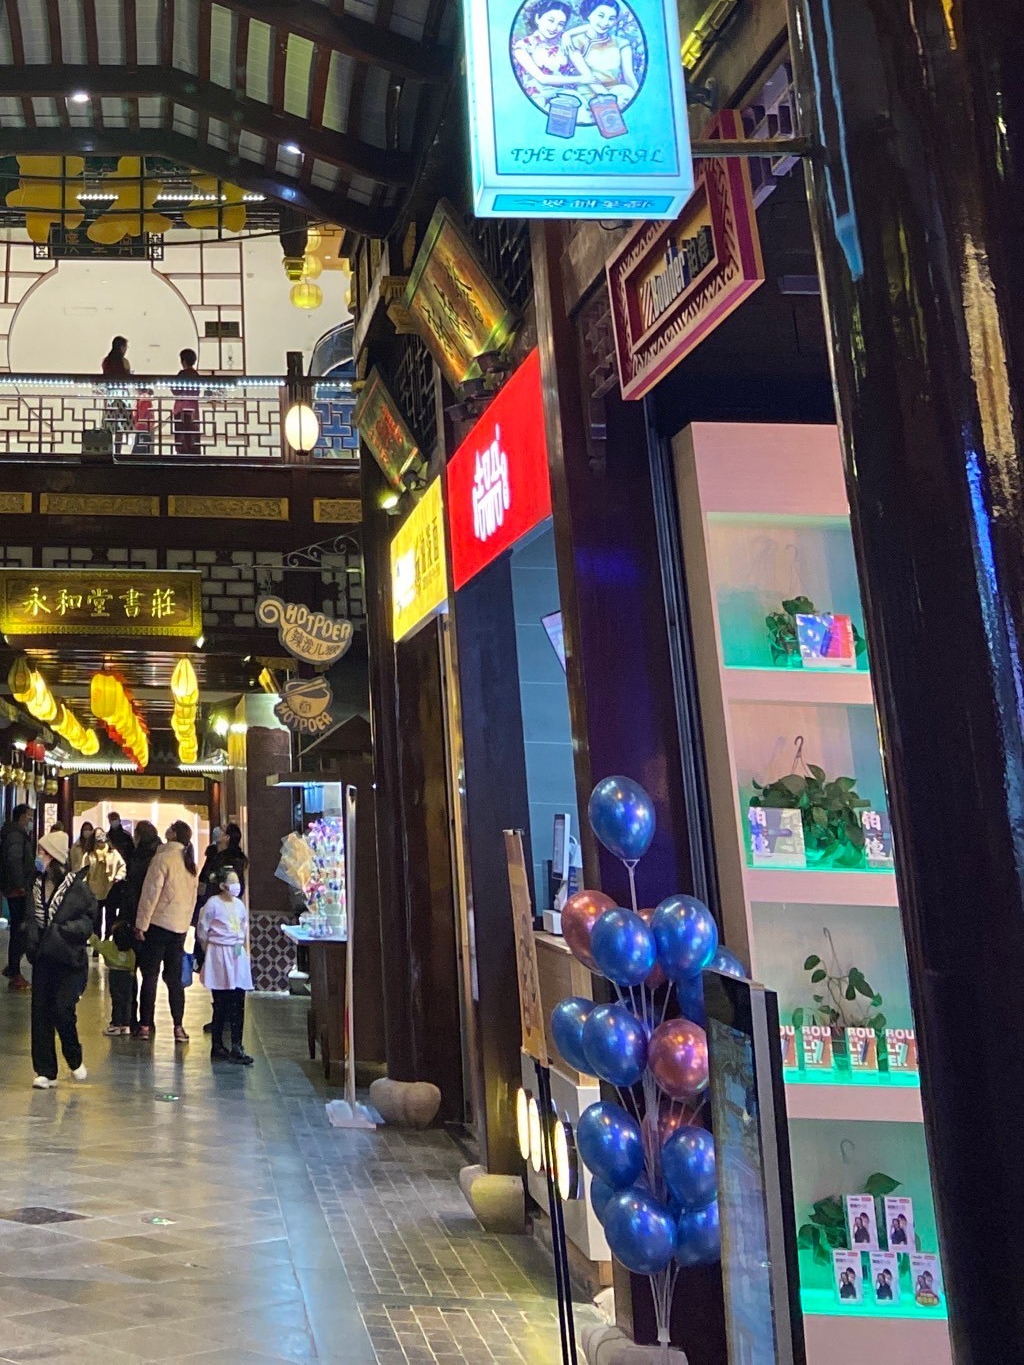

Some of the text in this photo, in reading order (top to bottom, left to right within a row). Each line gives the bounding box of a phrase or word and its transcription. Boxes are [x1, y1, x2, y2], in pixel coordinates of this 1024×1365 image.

[511, 144, 665, 166] THE CENTRAL
[22, 585, 177, 619] 永和堂書莊
